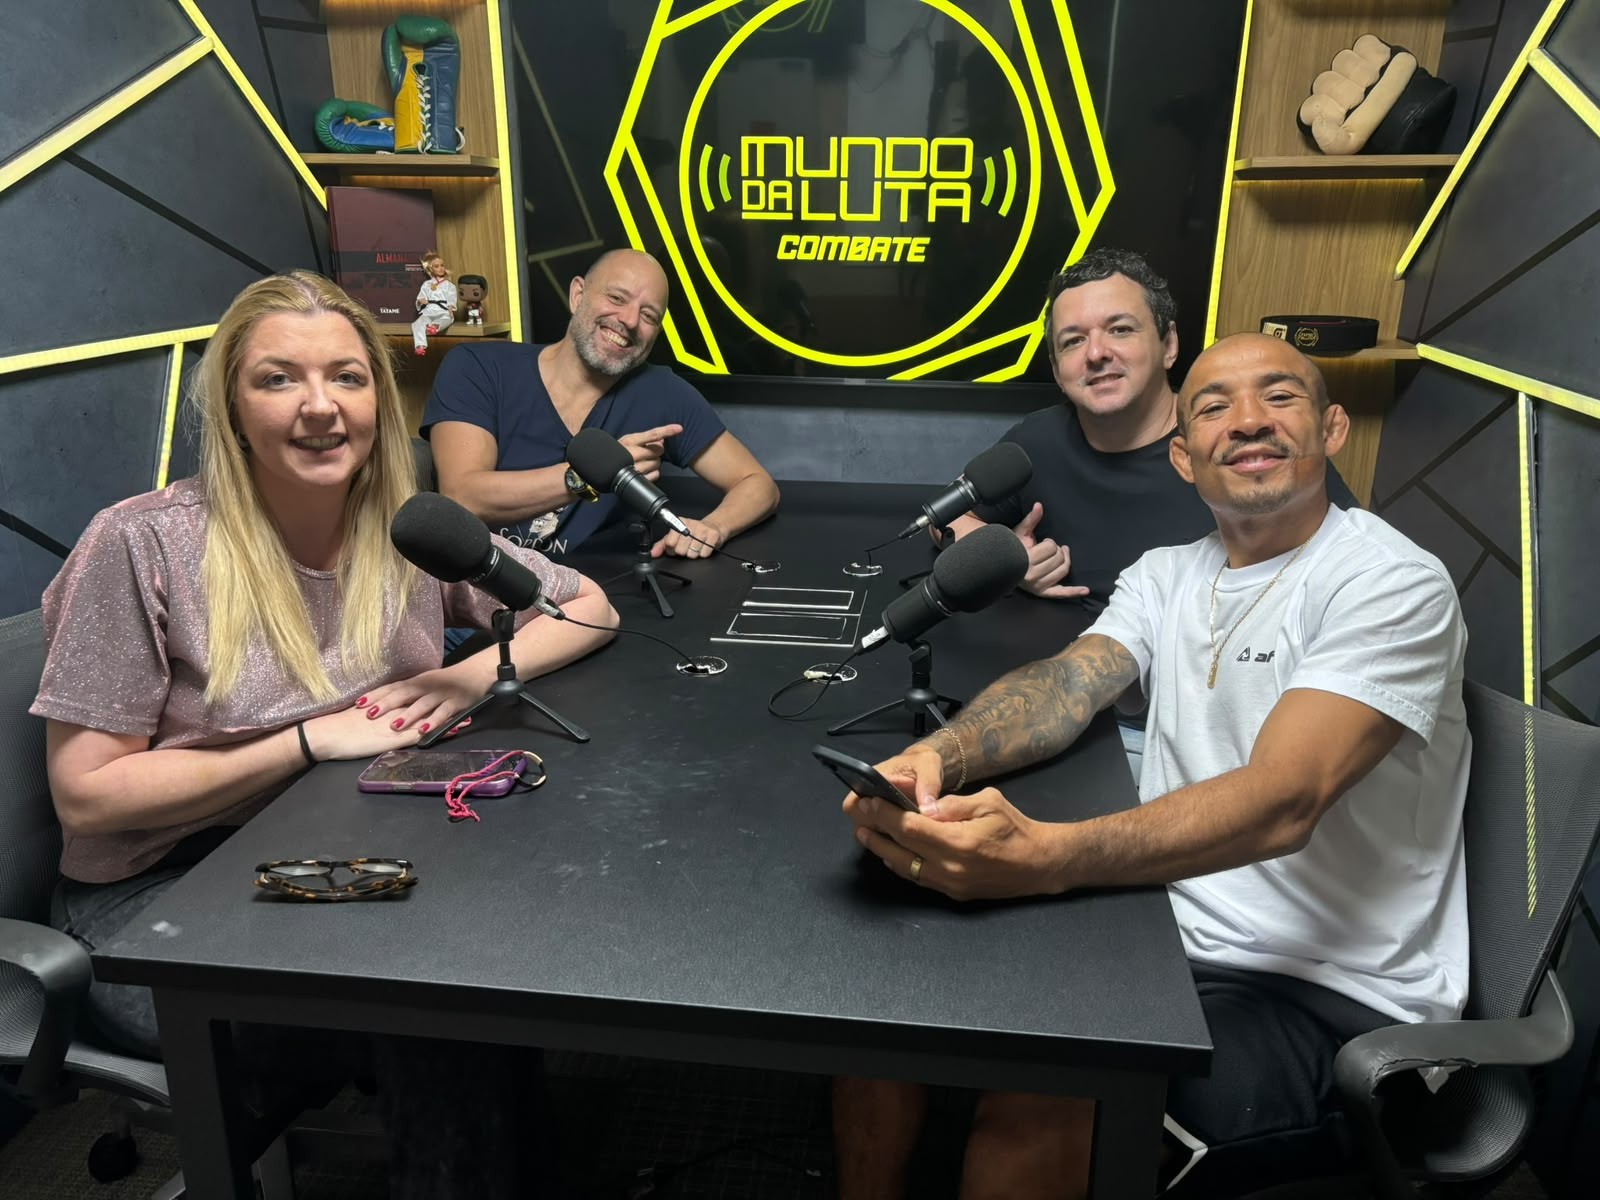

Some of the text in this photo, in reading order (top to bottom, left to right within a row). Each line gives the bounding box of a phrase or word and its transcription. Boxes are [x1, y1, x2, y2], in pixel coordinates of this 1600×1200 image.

[741, 136, 974, 179] MUNDO
[742, 180, 971, 223] DA LUTA
[777, 234, 931, 263] COMBATE
